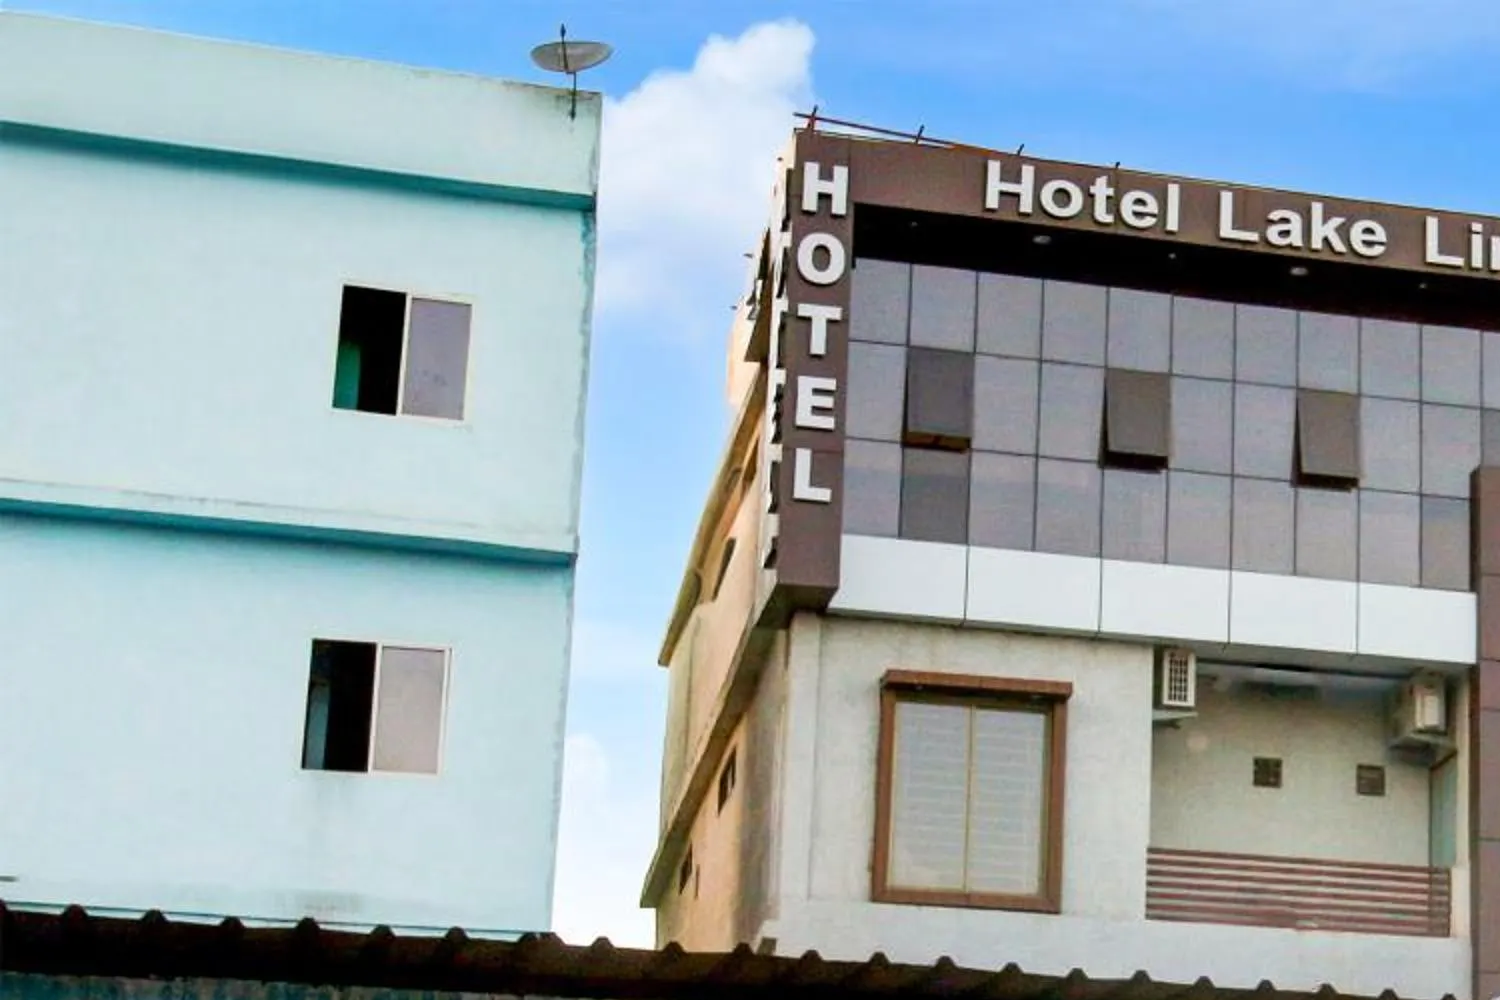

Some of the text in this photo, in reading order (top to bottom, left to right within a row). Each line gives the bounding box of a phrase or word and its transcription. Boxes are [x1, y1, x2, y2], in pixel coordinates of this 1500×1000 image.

[984, 159, 1180, 234] Hotel
[1218, 191, 1387, 257] Lake
[793, 161, 848, 503] HOTEL
